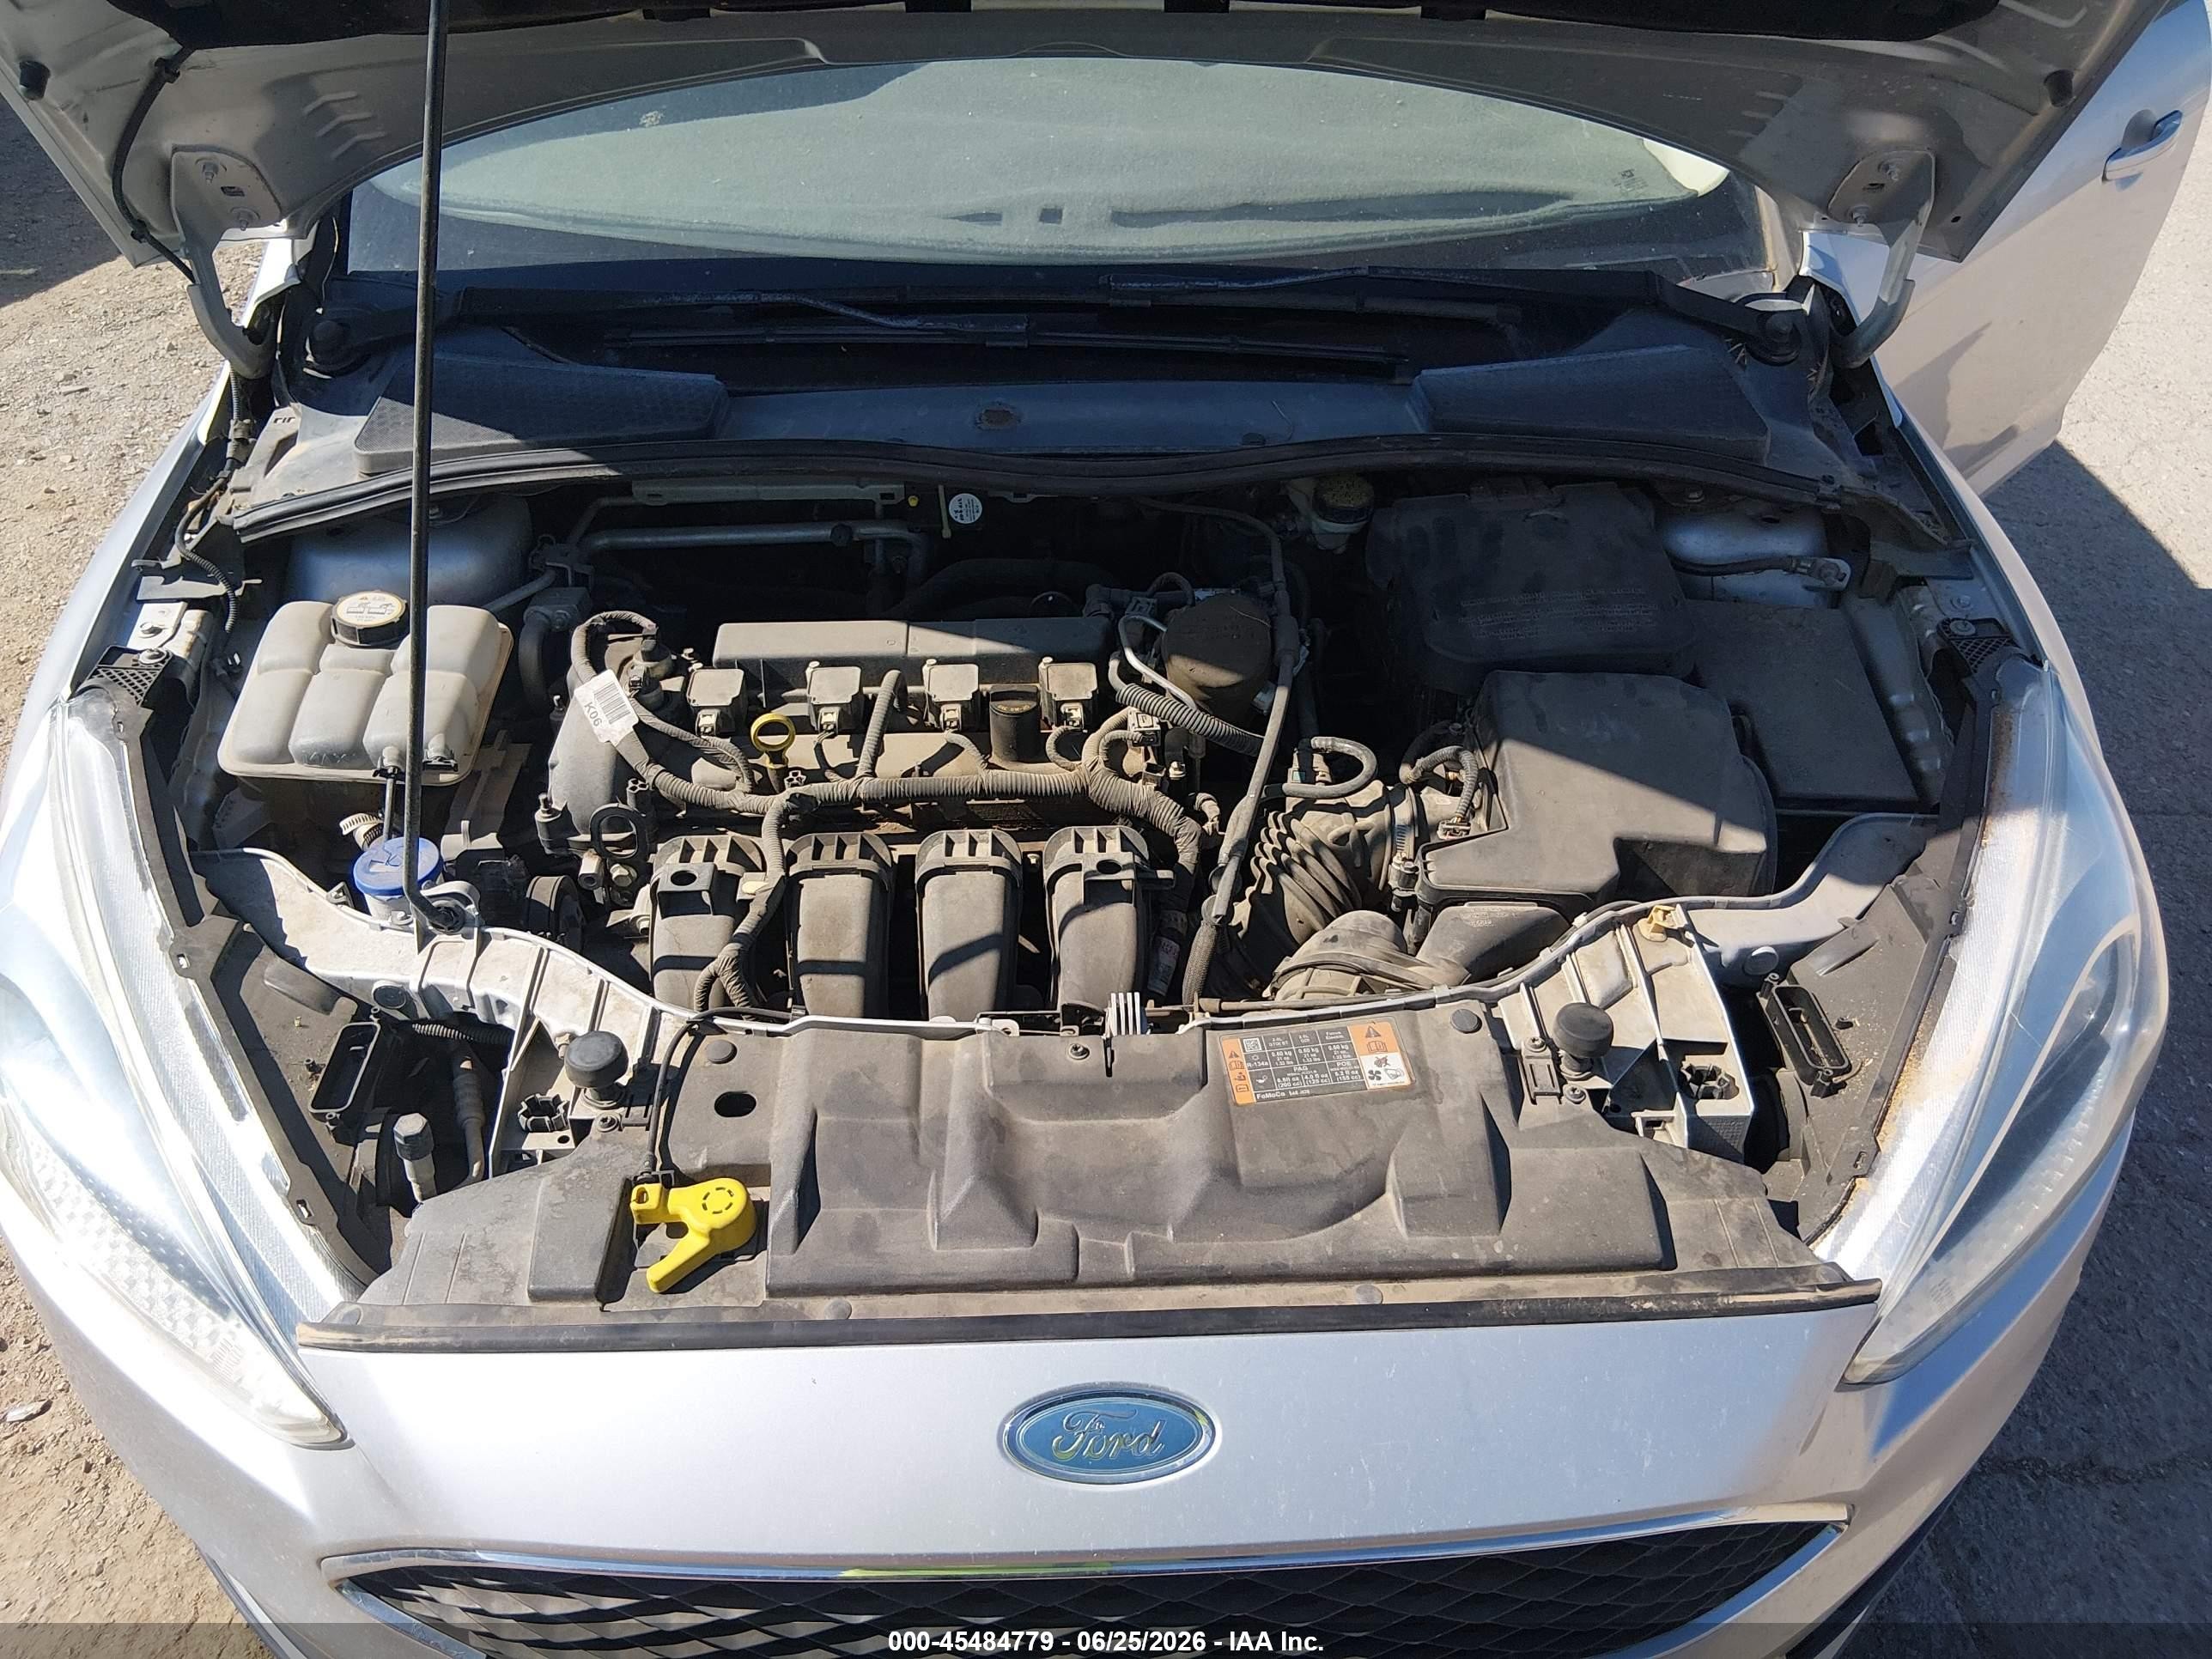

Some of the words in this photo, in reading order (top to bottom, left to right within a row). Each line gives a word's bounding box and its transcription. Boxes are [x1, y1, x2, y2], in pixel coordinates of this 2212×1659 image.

[584, 702, 603, 727] K06
[1255, 1091, 1285, 1099] FoMoCo
[1051, 1408, 1166, 1462] Ford
